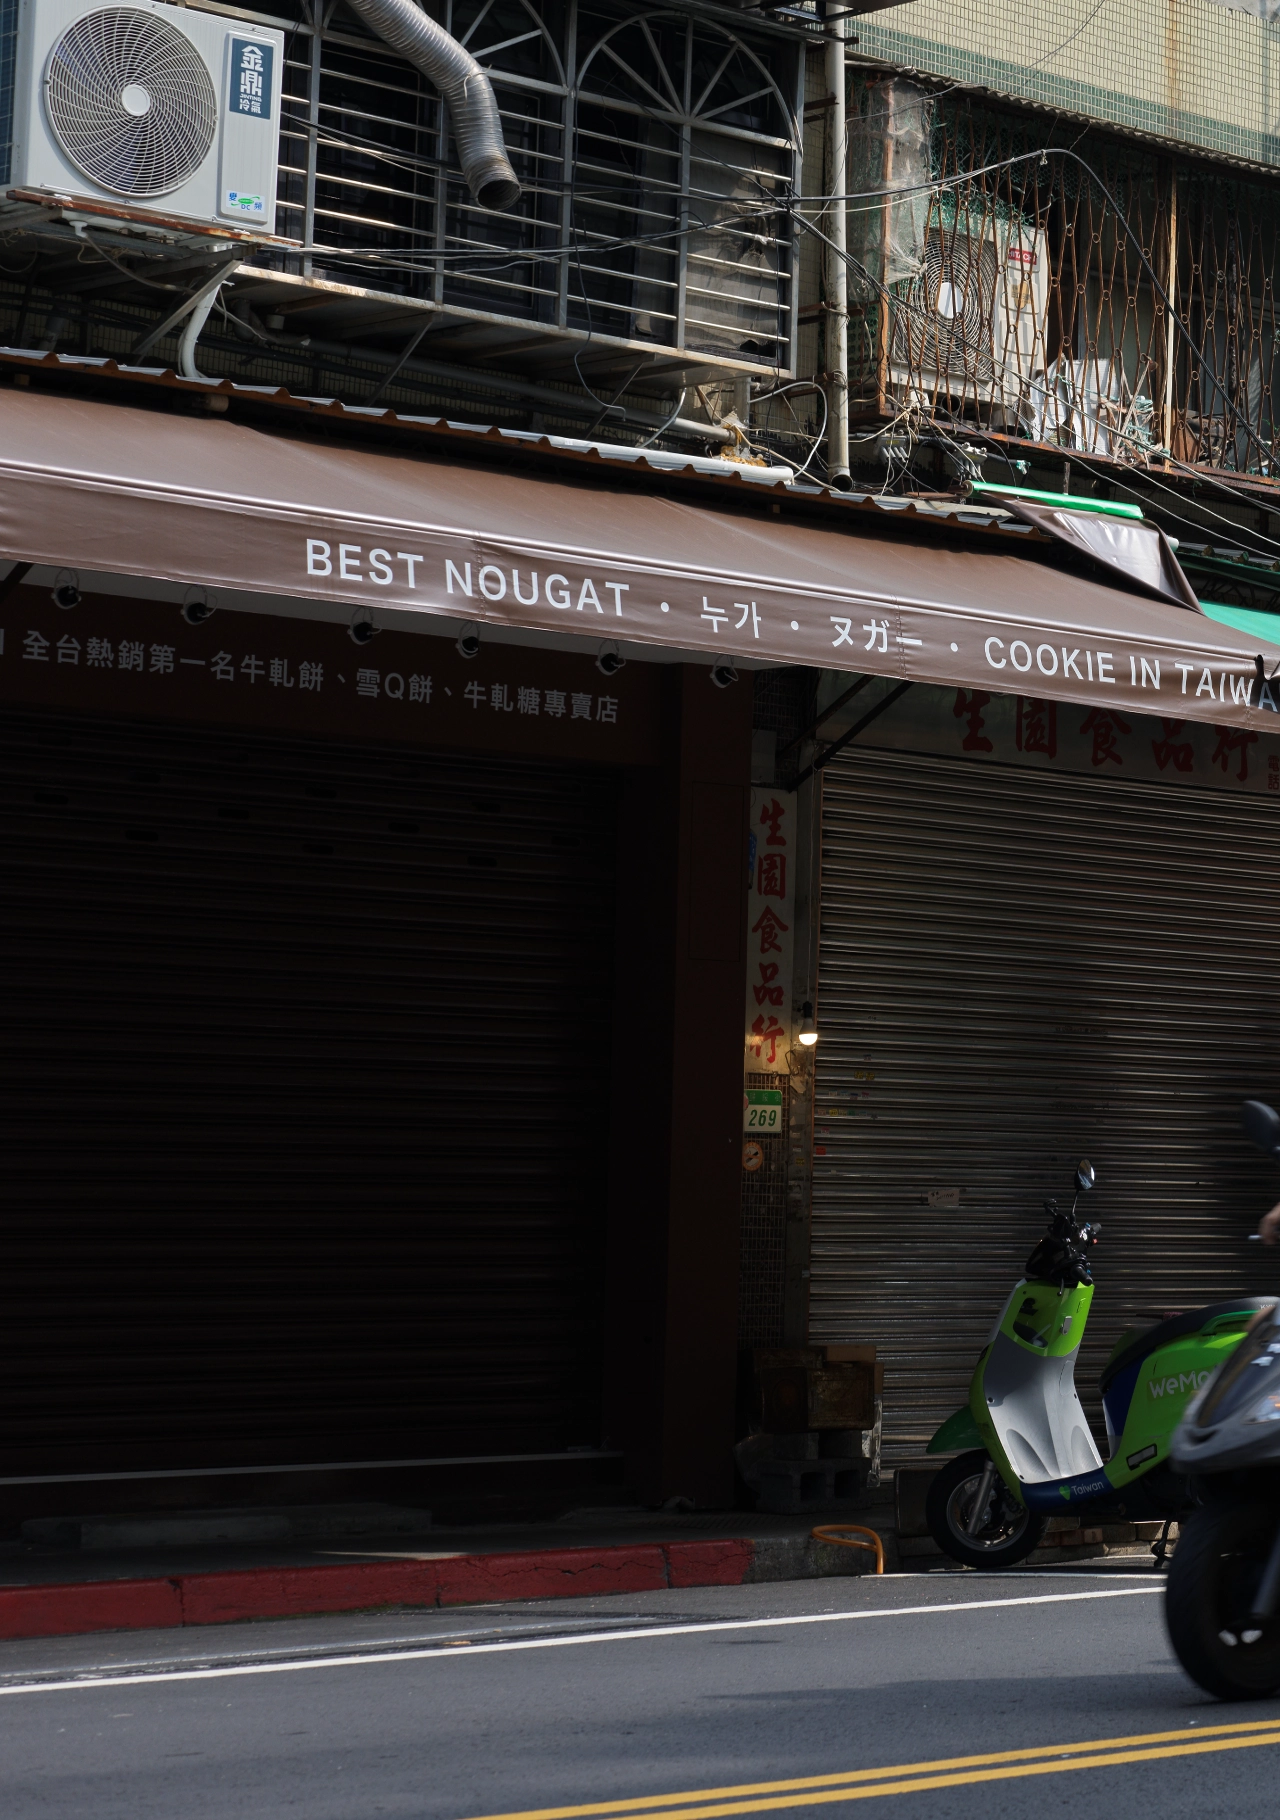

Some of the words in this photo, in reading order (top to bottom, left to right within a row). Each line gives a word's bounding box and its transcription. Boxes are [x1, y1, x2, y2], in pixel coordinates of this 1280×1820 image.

[240, 45, 264, 96] 金鼎
[239, 98, 262, 114] 冷氣
[306, 538, 424, 589] BEST
[445, 558, 630, 617] NOUGAT
[700, 596, 762, 639] 누가
[830, 616, 923, 653] ヌガー
[984, 636, 1116, 684] COOKIE
[1129, 655, 1161, 690] IN
[748, 1109, 777, 1127] 269
[1070, 1481, 1105, 1496] Taiwan
